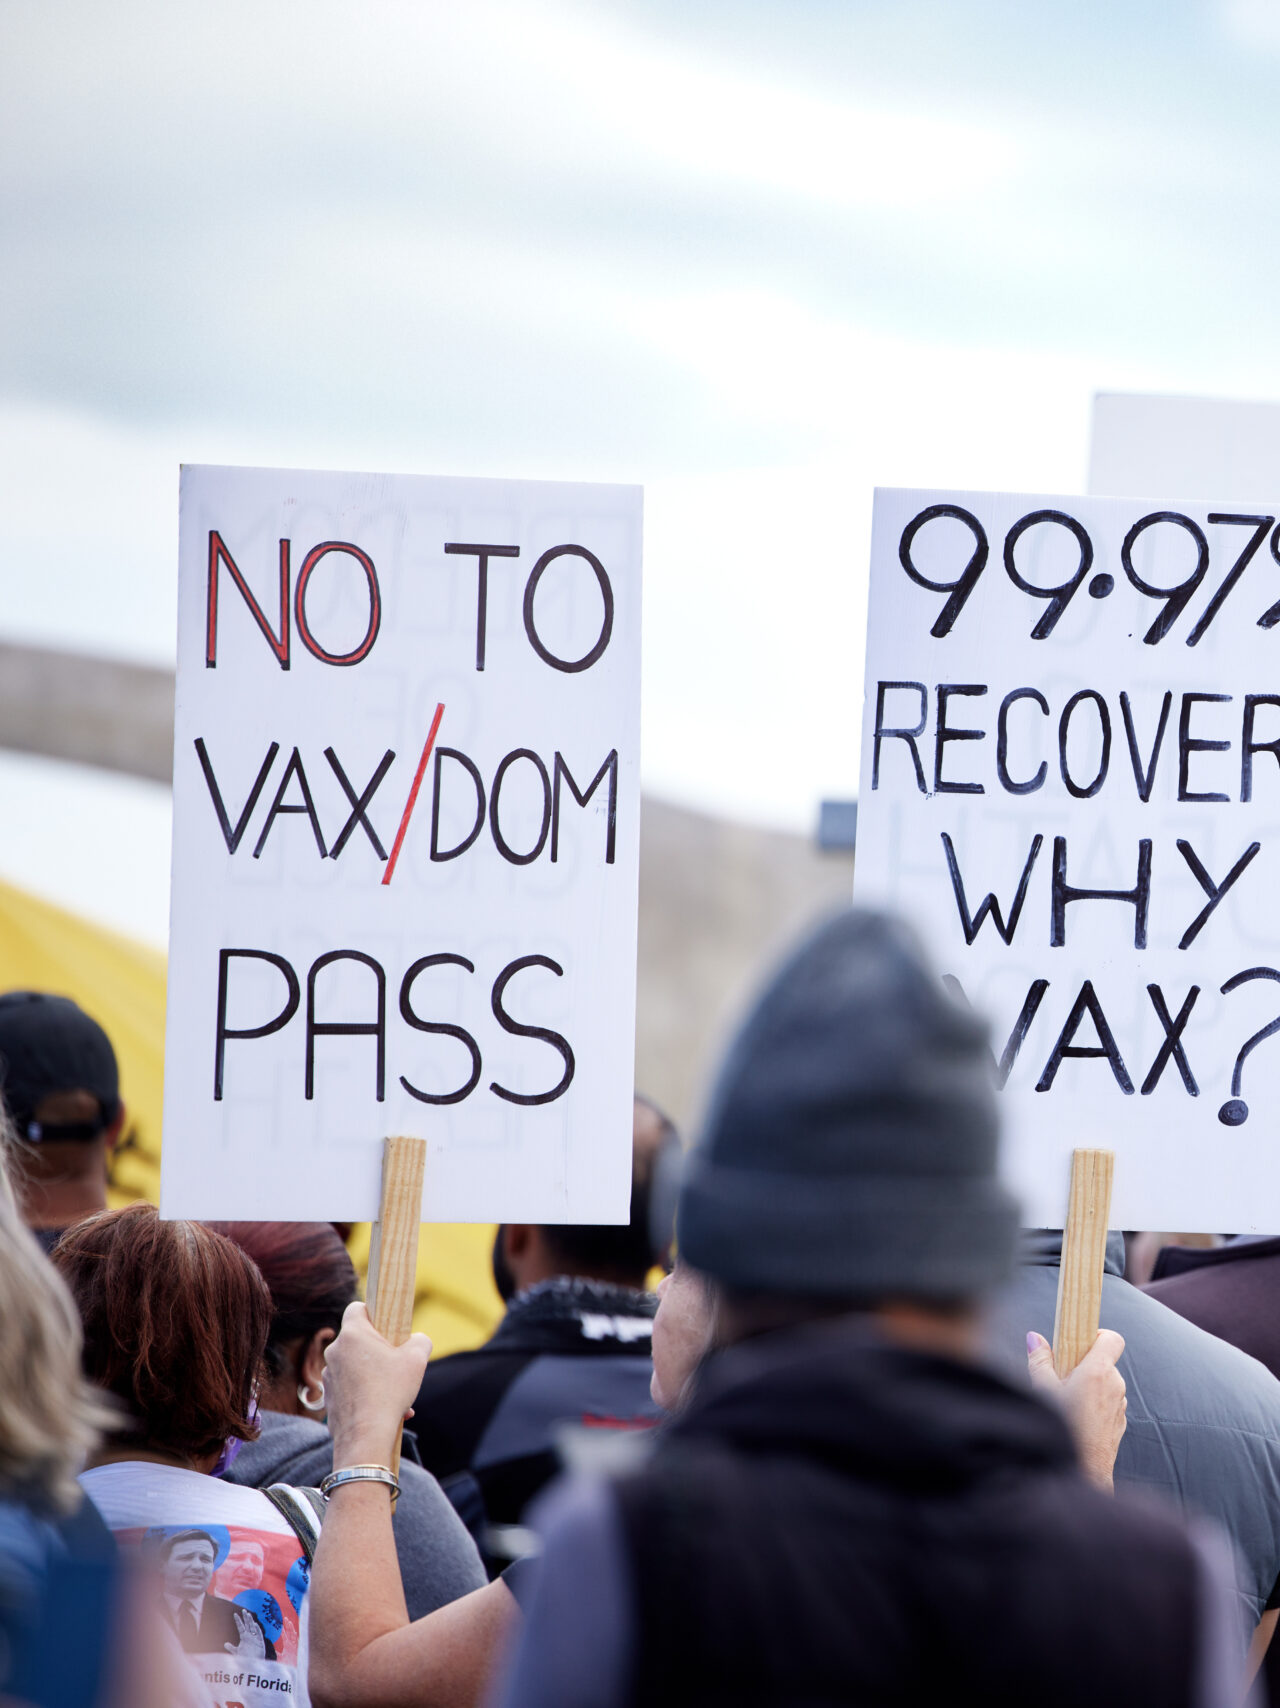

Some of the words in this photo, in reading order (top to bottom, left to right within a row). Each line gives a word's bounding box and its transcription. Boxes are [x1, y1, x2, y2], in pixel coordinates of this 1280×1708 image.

[205, 529, 382, 672] NO
[444, 542, 615, 674] TO
[193, 703, 618, 885] VAX/DOM
[940, 831, 1261, 951] WHY
[213, 948, 576, 1106] PASS
[232, 1673, 244, 1686] of
